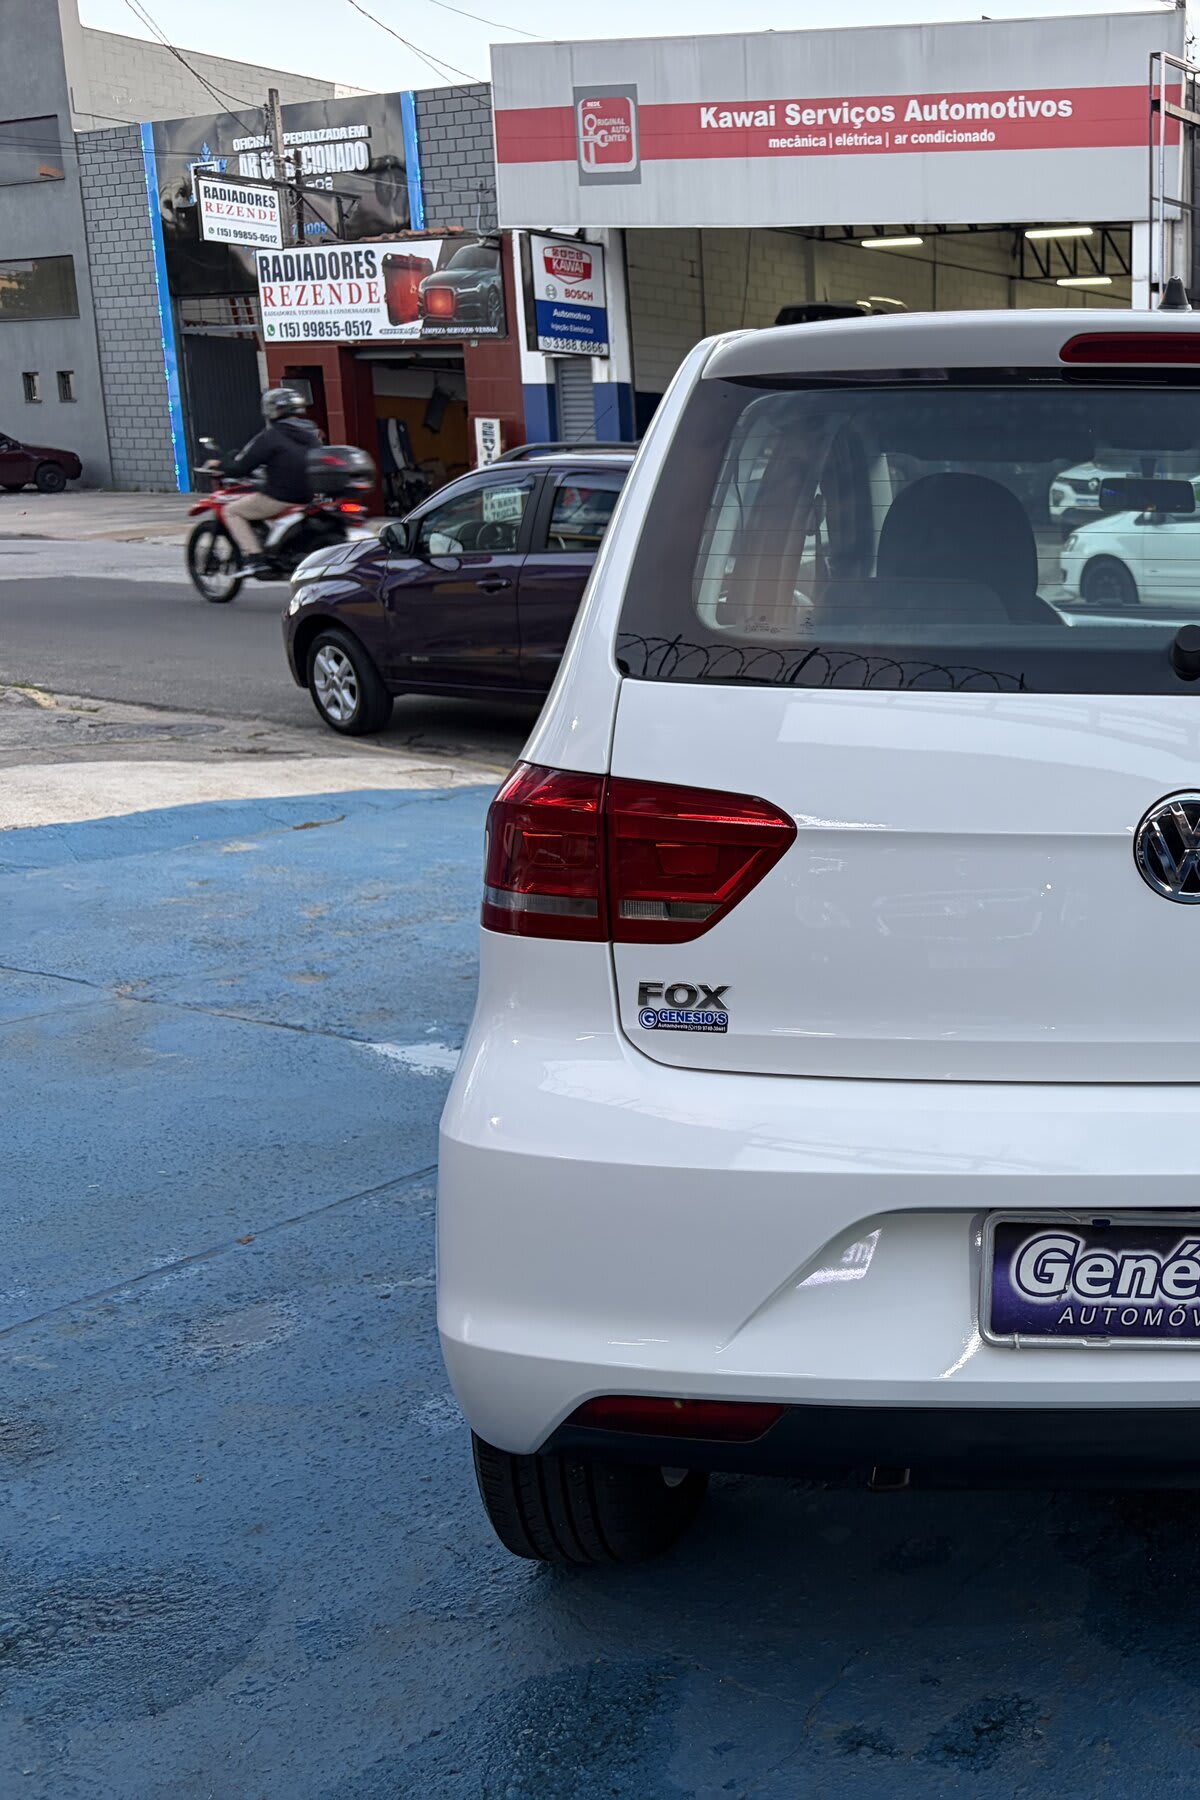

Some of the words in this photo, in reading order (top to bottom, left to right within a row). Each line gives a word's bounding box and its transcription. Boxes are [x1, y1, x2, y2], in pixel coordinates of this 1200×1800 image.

[701, 104, 776, 129] Kawai
[784, 101, 896, 129] Serviços
[904, 95, 1073, 122] Automotivos
[348, 125, 369, 138] EM
[611, 126, 630, 134] AUTO
[768, 133, 827, 148] mecânica
[835, 130, 882, 147] elétrica
[894, 132, 908, 146] ar
[911, 129, 995, 145] condicionado
[239, 152, 261, 179] AR
[203, 185, 276, 209] RADIADORES
[204, 201, 278, 222] REZENDE
[217, 227, 231, 238] (15)
[233, 229, 278, 244] 99855-0512
[258, 249, 378, 283] RADIADORES
[552, 258, 584, 273] KAWAI
[261, 281, 381, 308] REZENDE
[564, 288, 594, 301] BOSCH
[279, 321, 300, 338] (15)
[303, 320, 373, 338] 99855-0512
[637, 980, 732, 1011] FOX
[658, 1010, 728, 1026] GENESIO'S
